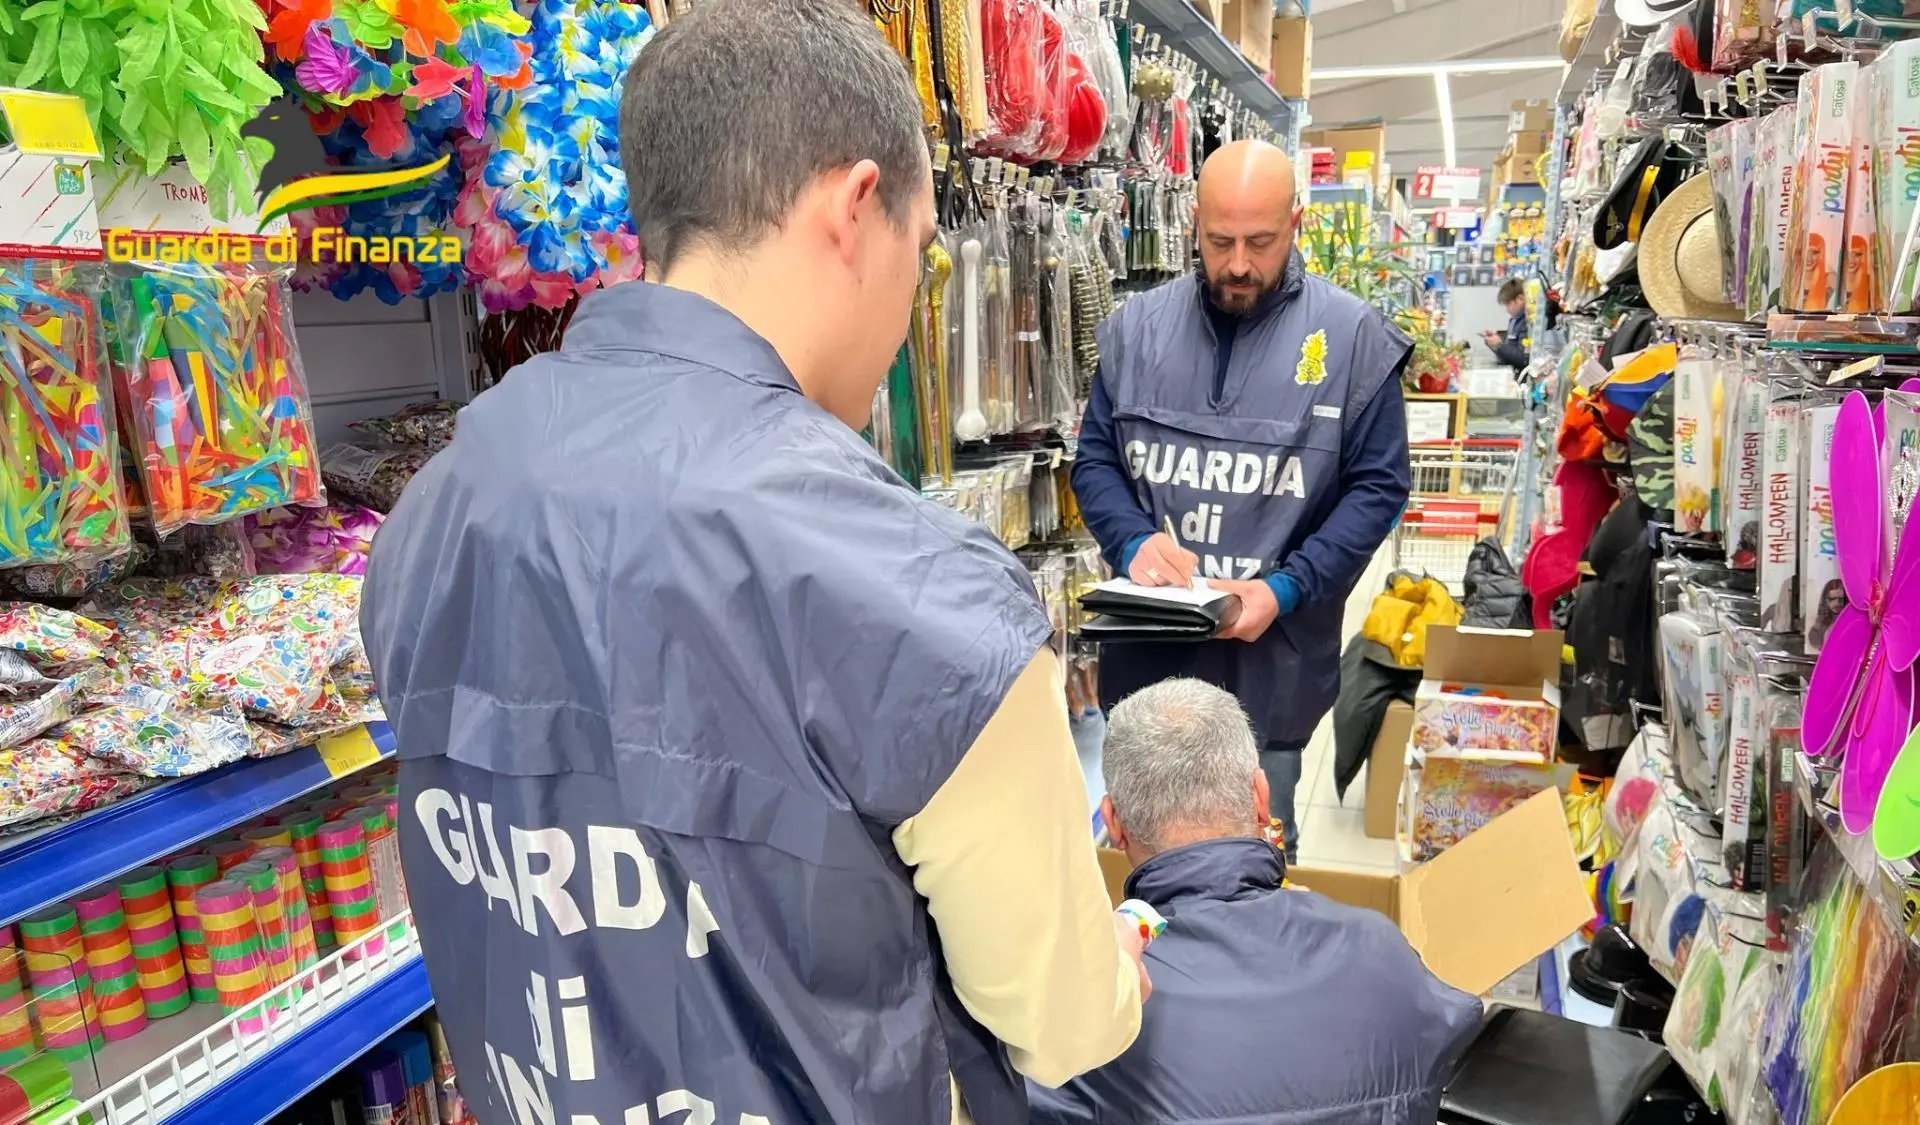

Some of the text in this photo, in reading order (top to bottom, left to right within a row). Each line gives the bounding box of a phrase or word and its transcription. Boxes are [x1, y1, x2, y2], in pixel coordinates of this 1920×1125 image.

[160, 182, 208, 204] TROMB
[1418, 175, 1431, 196] 2
[1817, 143, 1851, 213] party!
[1124, 440, 1306, 498] GUARDIA
[1675, 416, 1697, 465] party!
[1739, 432, 1760, 511] HALLOWEEN
[1181, 503, 1224, 545] di
[1769, 473, 1793, 564] HALLOWEEN
[1730, 737, 1750, 825] HALLOWEEN
[526, 970, 596, 1081] di
